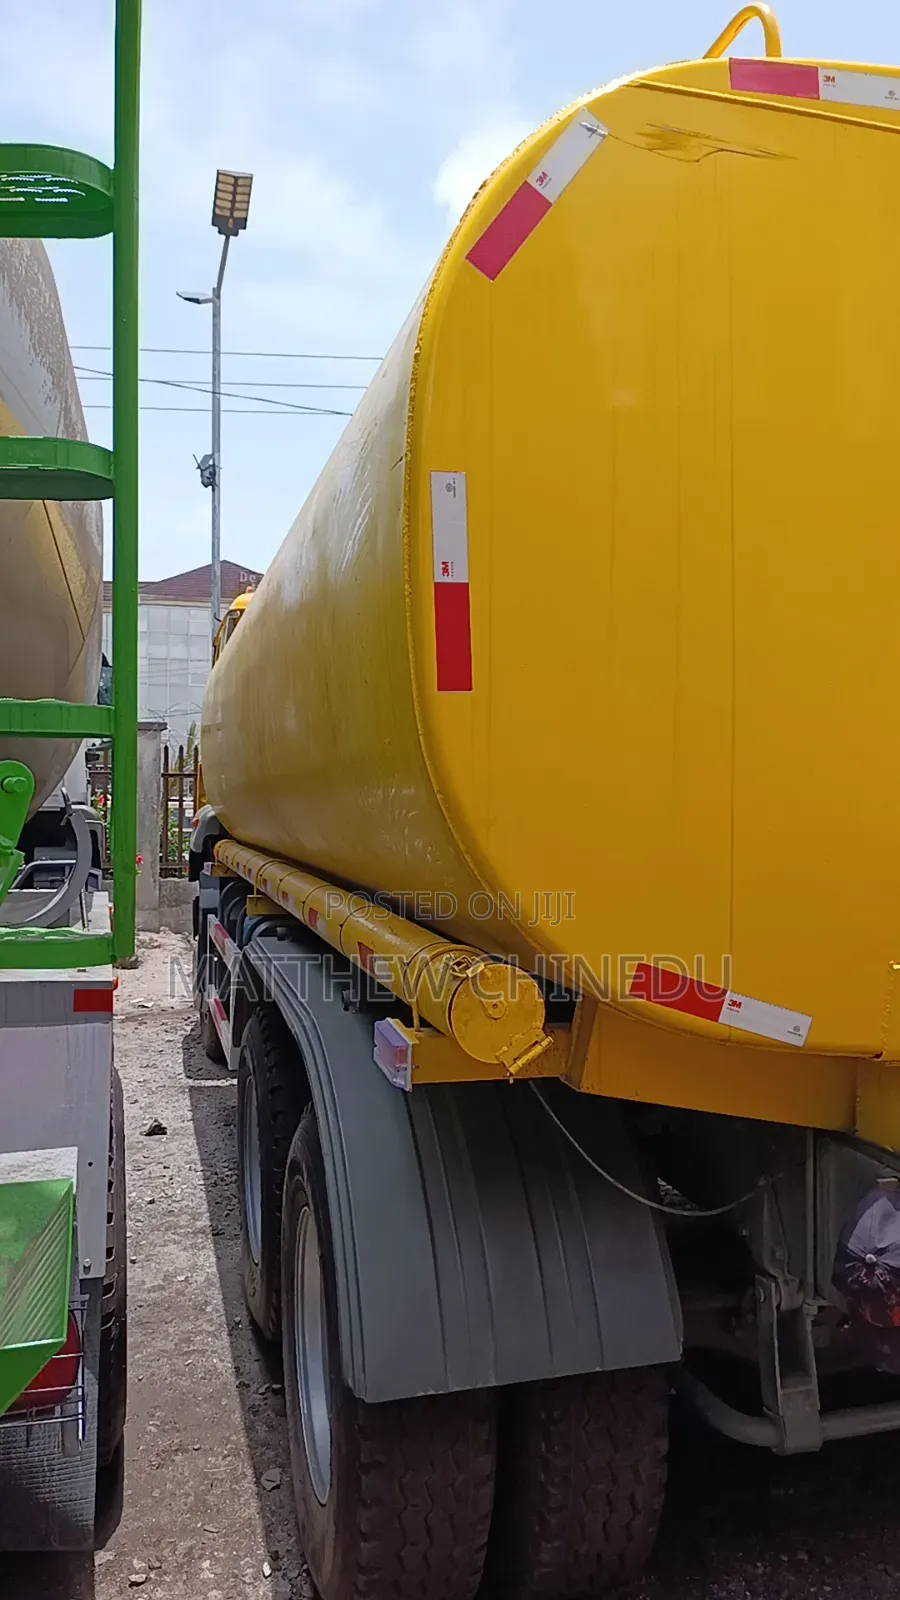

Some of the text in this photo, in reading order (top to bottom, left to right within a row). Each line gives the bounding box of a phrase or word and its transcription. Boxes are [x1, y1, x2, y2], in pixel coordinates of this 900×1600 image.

[823, 75, 836, 83] 3M
[536, 171, 549, 186] 3M
[441, 561, 450, 577] 3M
[728, 999, 742, 1009] 3M
